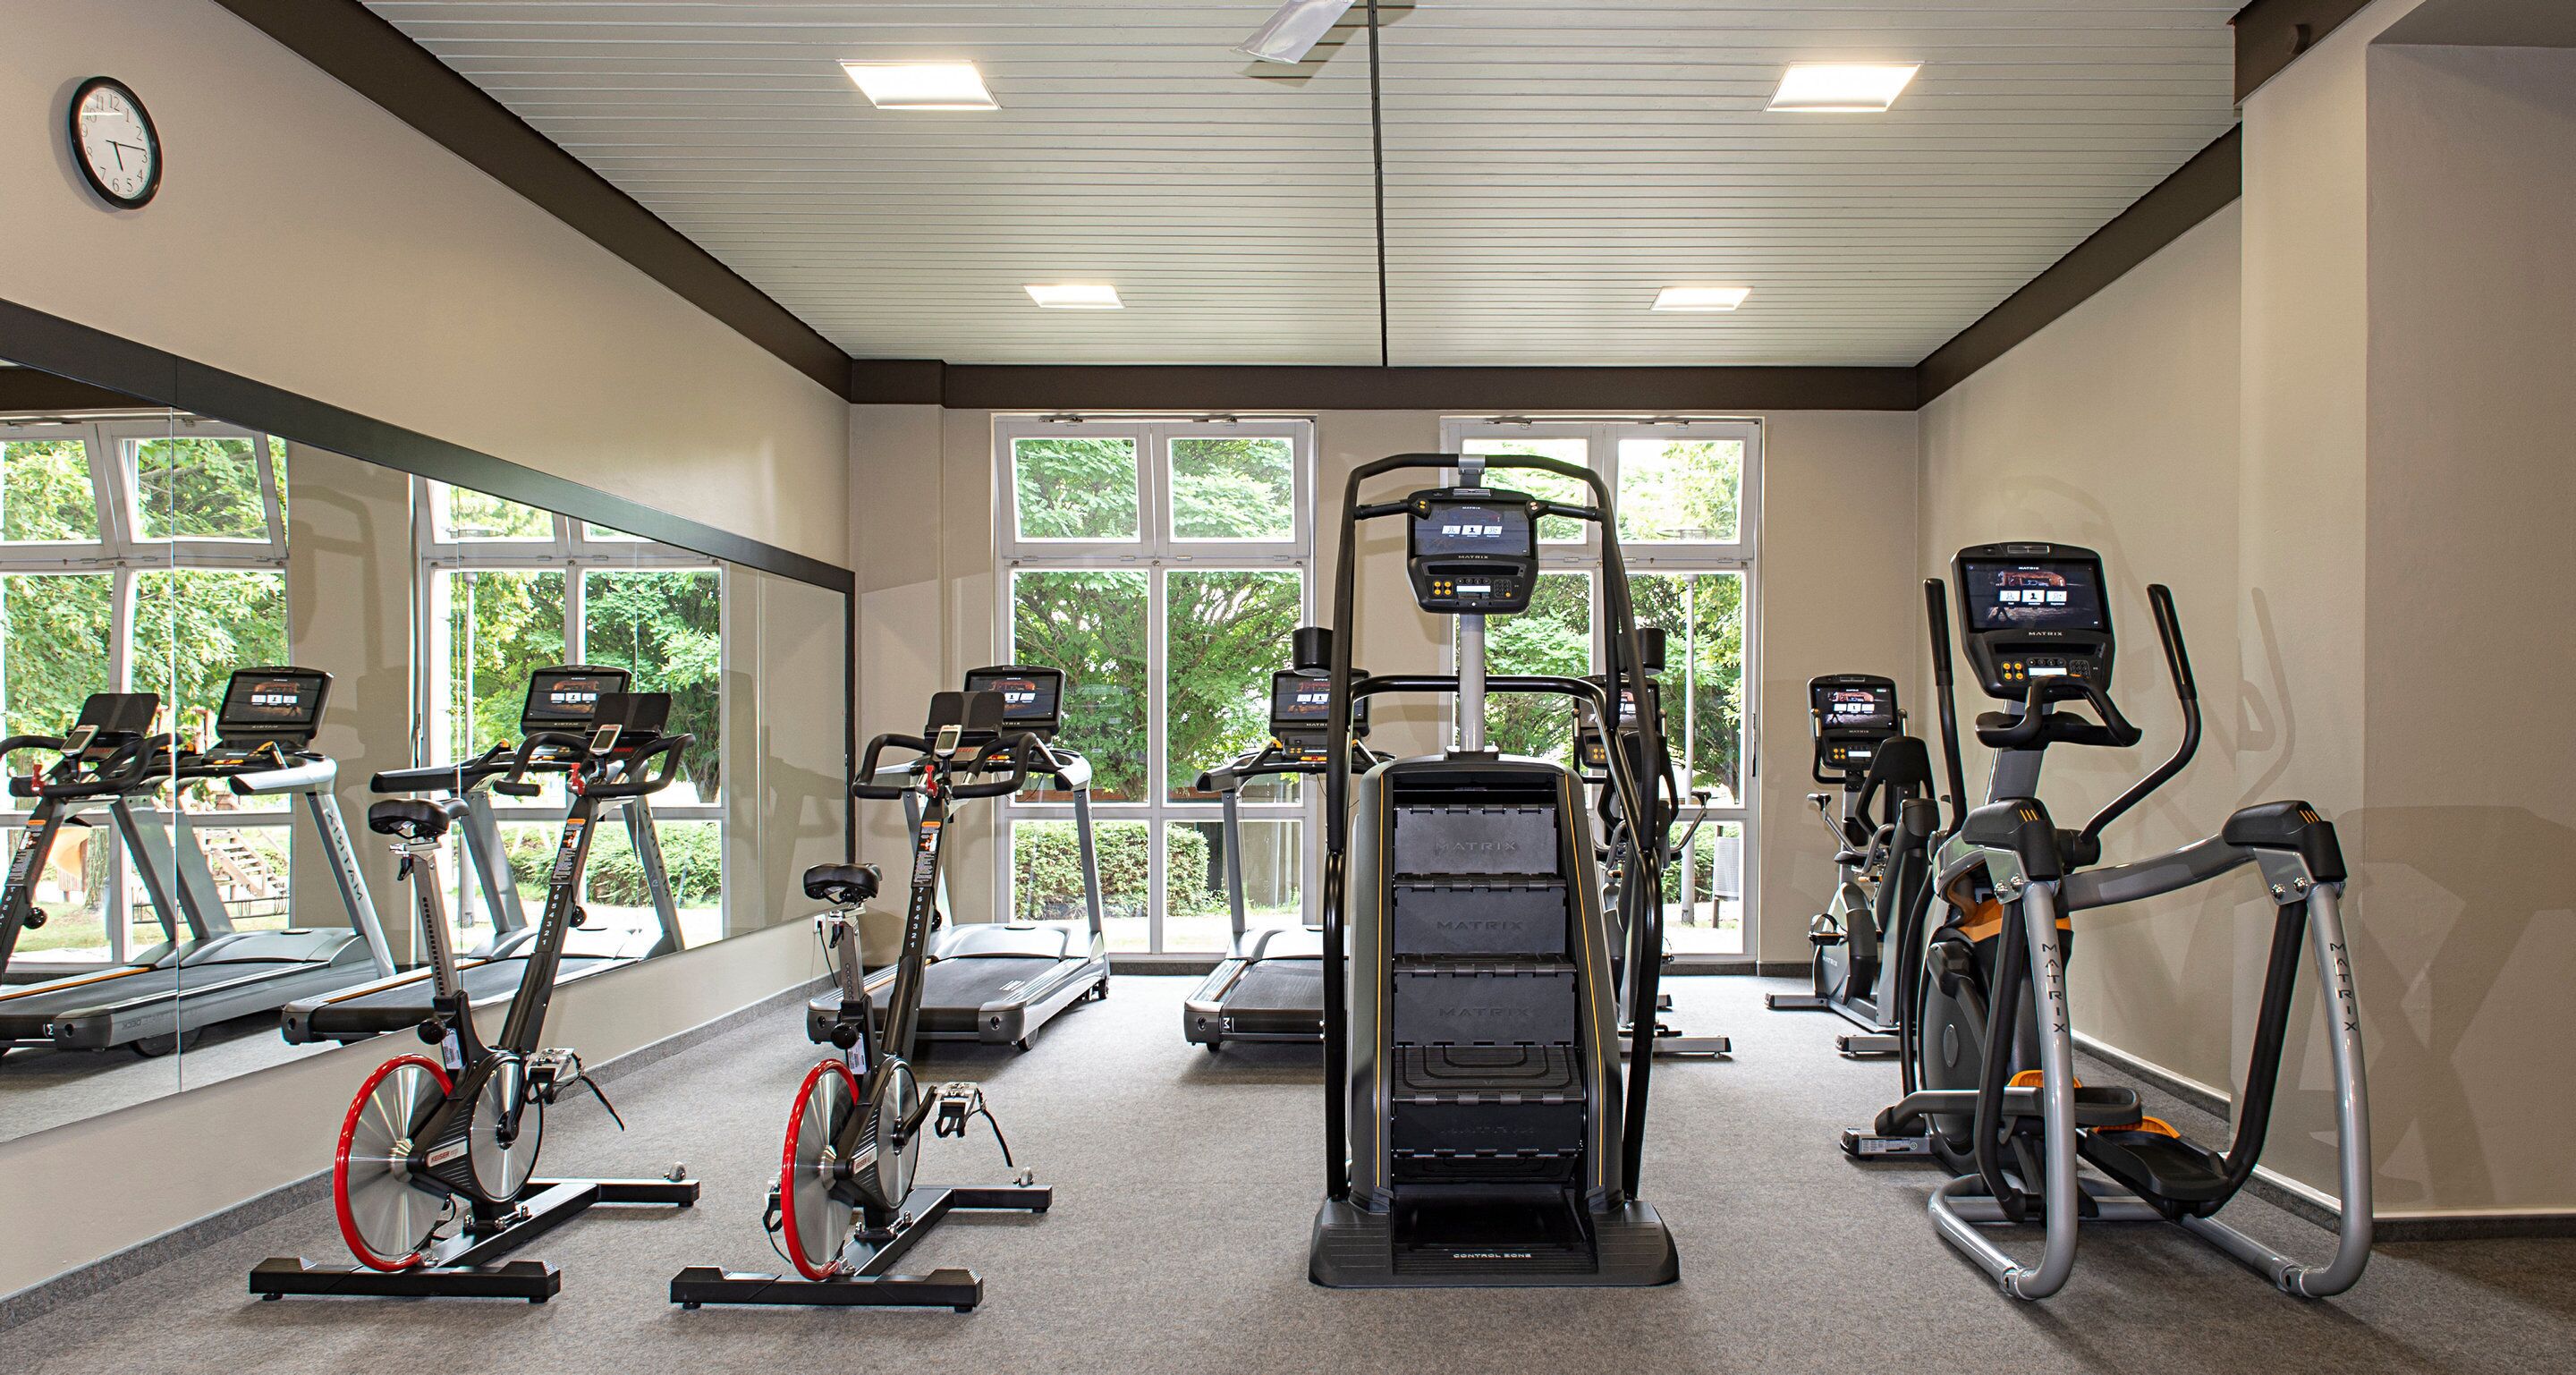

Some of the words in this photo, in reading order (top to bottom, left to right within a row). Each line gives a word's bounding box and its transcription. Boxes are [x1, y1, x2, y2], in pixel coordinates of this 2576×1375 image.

[96, 94, 105, 111] 11
[109, 93, 120, 112] 12
[125, 107, 131, 123] 1
[80, 123, 89, 138] 9
[135, 125, 143, 141] 2
[141, 149, 148, 164] 3
[99, 166, 106, 181] 7
[136, 169, 143, 182] 4
[112, 178, 120, 192] 6
[126, 177, 133, 192] 5
[1436, 842, 1517, 851] MATRIX
[1436, 921, 1522, 930] MATRIX
[2042, 943, 2066, 1032] MATRIX
[2329, 943, 2358, 1031] MATRIX
[1438, 1008, 1531, 1017] MATRIX
